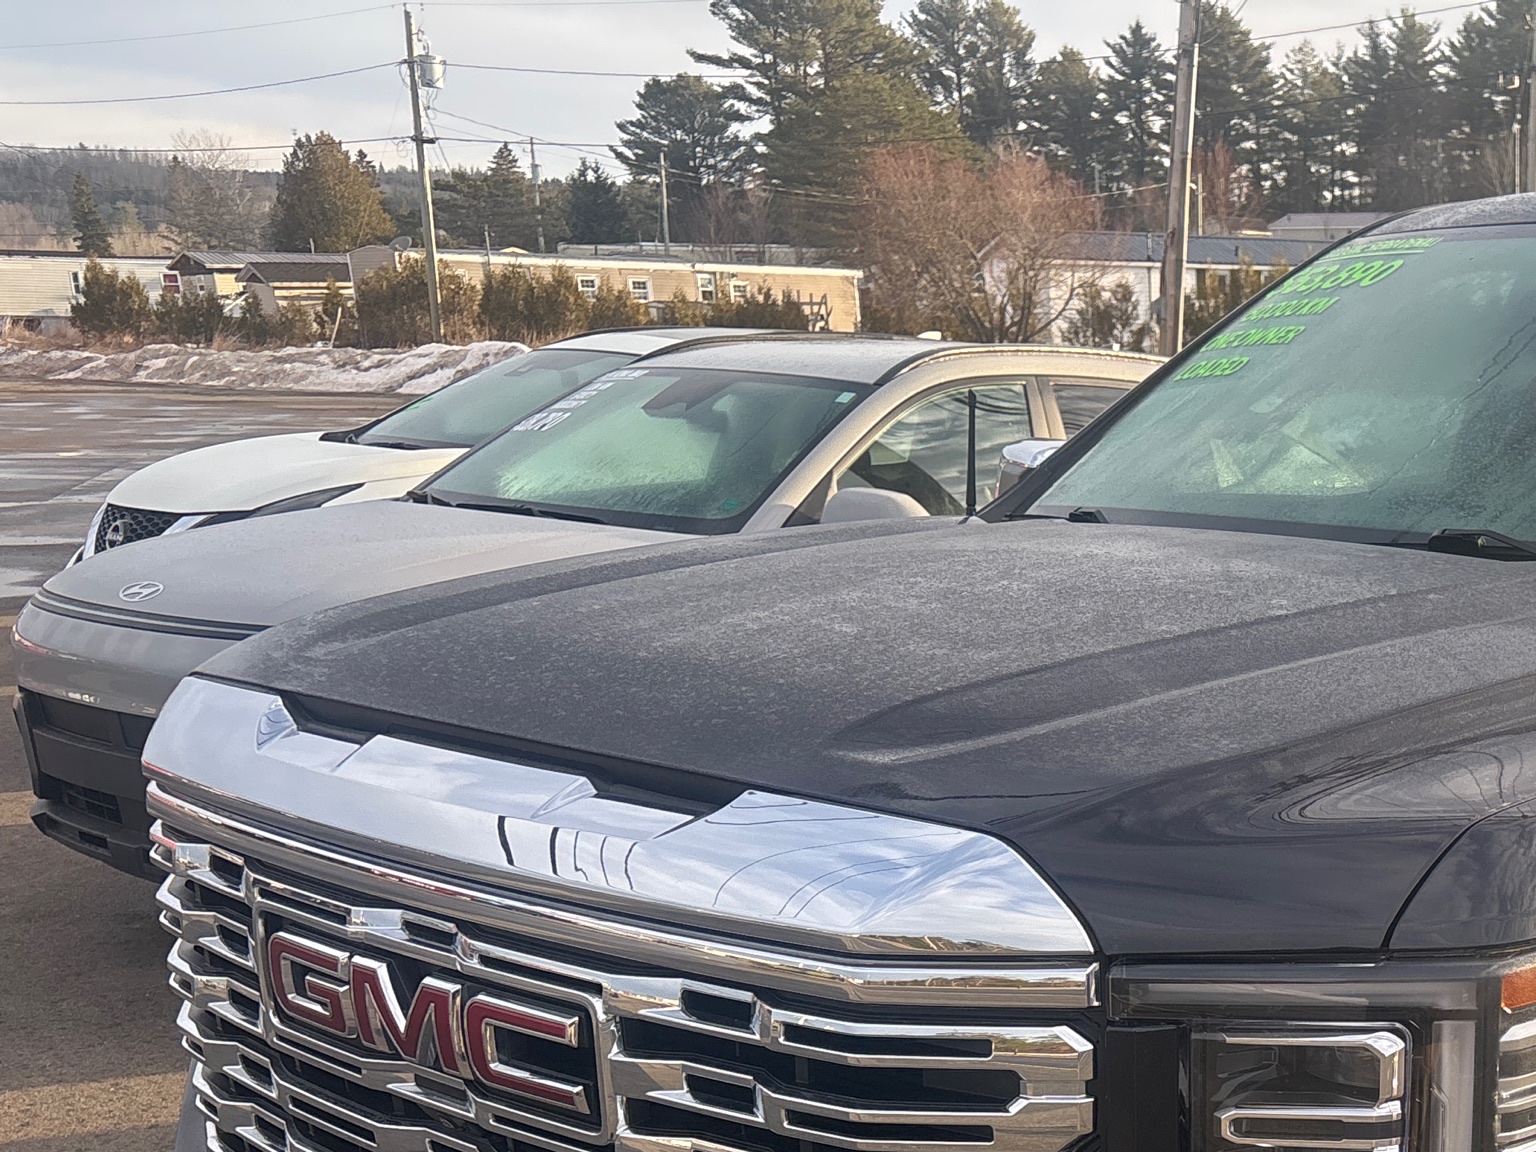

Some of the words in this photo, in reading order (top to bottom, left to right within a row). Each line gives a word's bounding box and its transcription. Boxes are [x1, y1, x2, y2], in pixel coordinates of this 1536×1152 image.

[1231, 325, 1306, 346] OWNER
[1173, 356, 1250, 381] LOADED
[268, 931, 591, 1115] GMC
